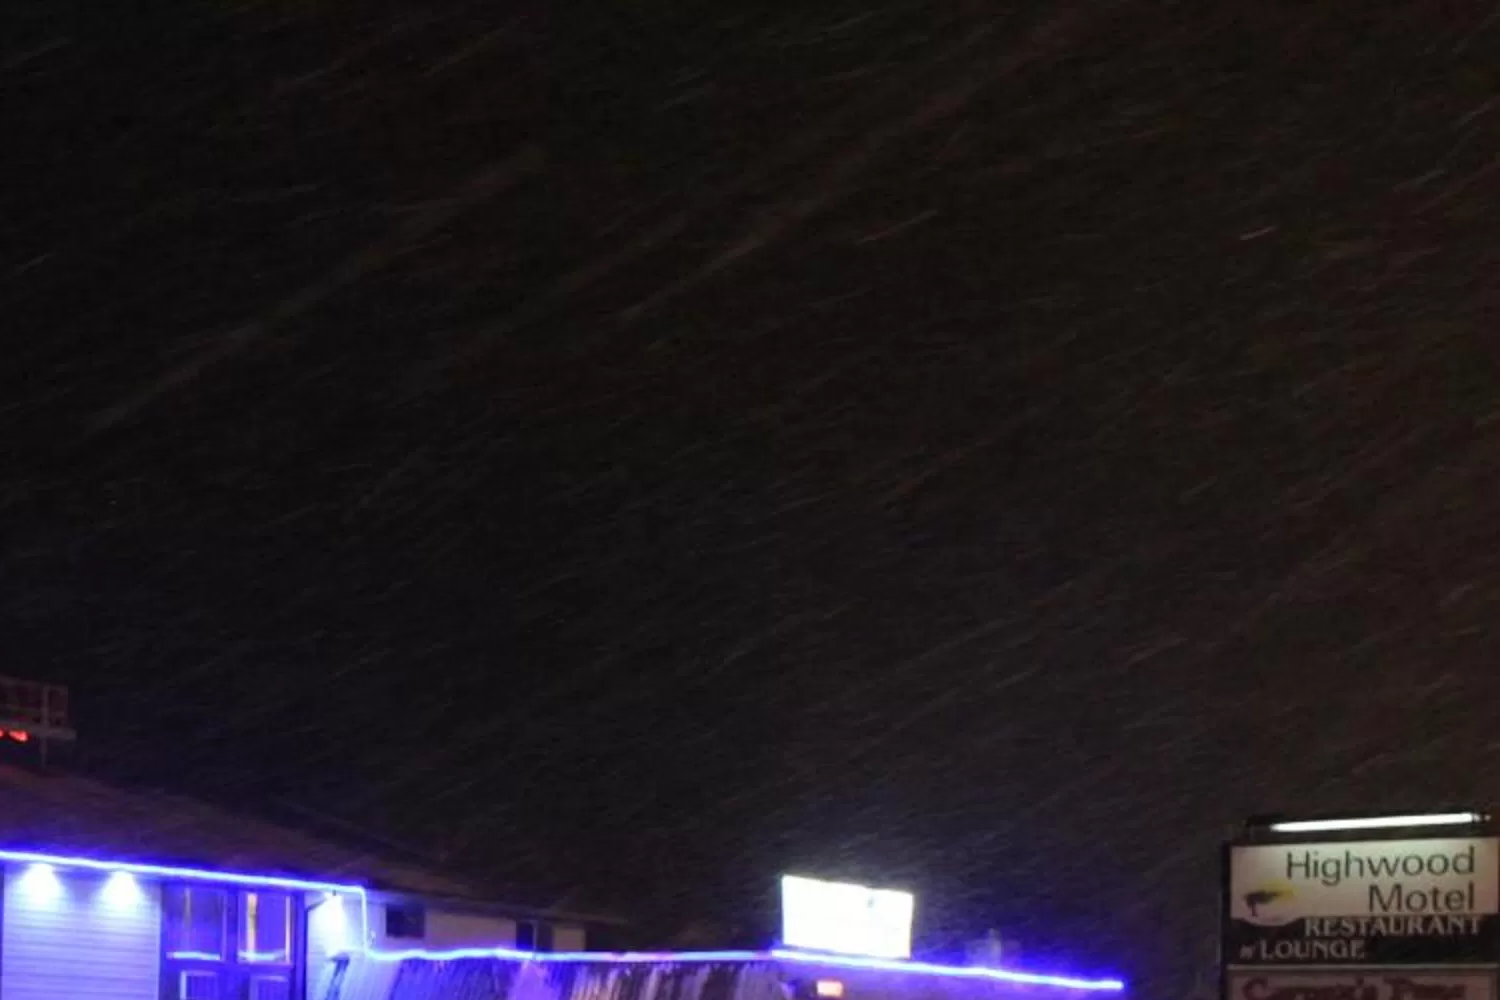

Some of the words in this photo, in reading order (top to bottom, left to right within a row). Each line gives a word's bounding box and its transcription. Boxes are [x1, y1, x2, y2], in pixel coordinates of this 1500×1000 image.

[1285, 845, 1476, 886] Highwood
[1368, 880, 1475, 913] Motel
[1304, 915, 1481, 937] RESTAURANT
[1259, 939, 1366, 960] LOUNGE
